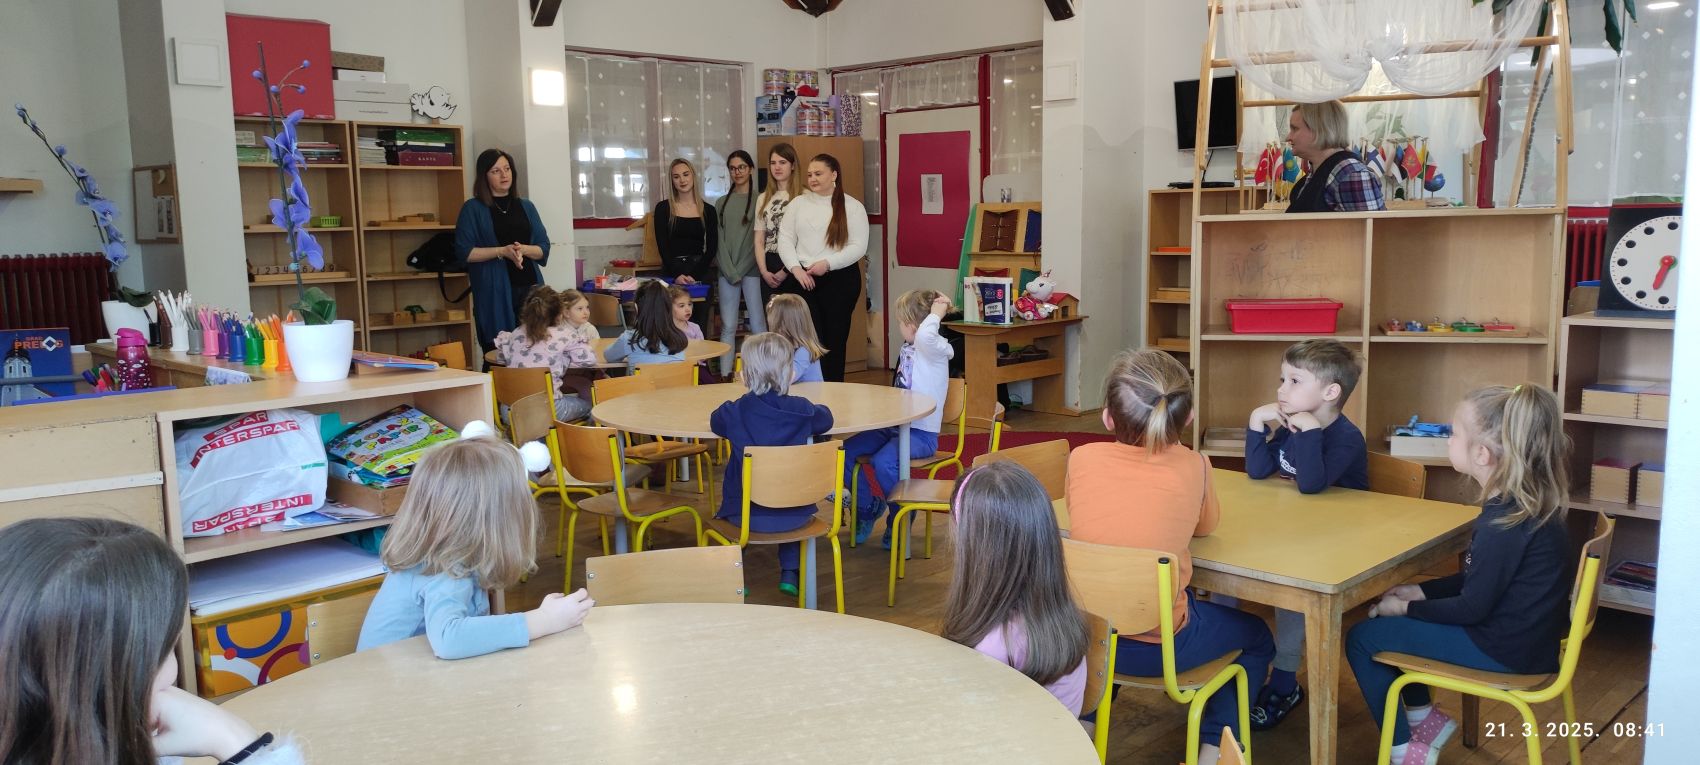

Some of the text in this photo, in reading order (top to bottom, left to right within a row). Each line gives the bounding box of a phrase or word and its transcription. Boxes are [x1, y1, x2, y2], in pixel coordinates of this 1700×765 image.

[214, 410, 268, 436] SPAR
[196, 421, 299, 460] INTERSPAR
[194, 497, 304, 531] INTERSPAR
